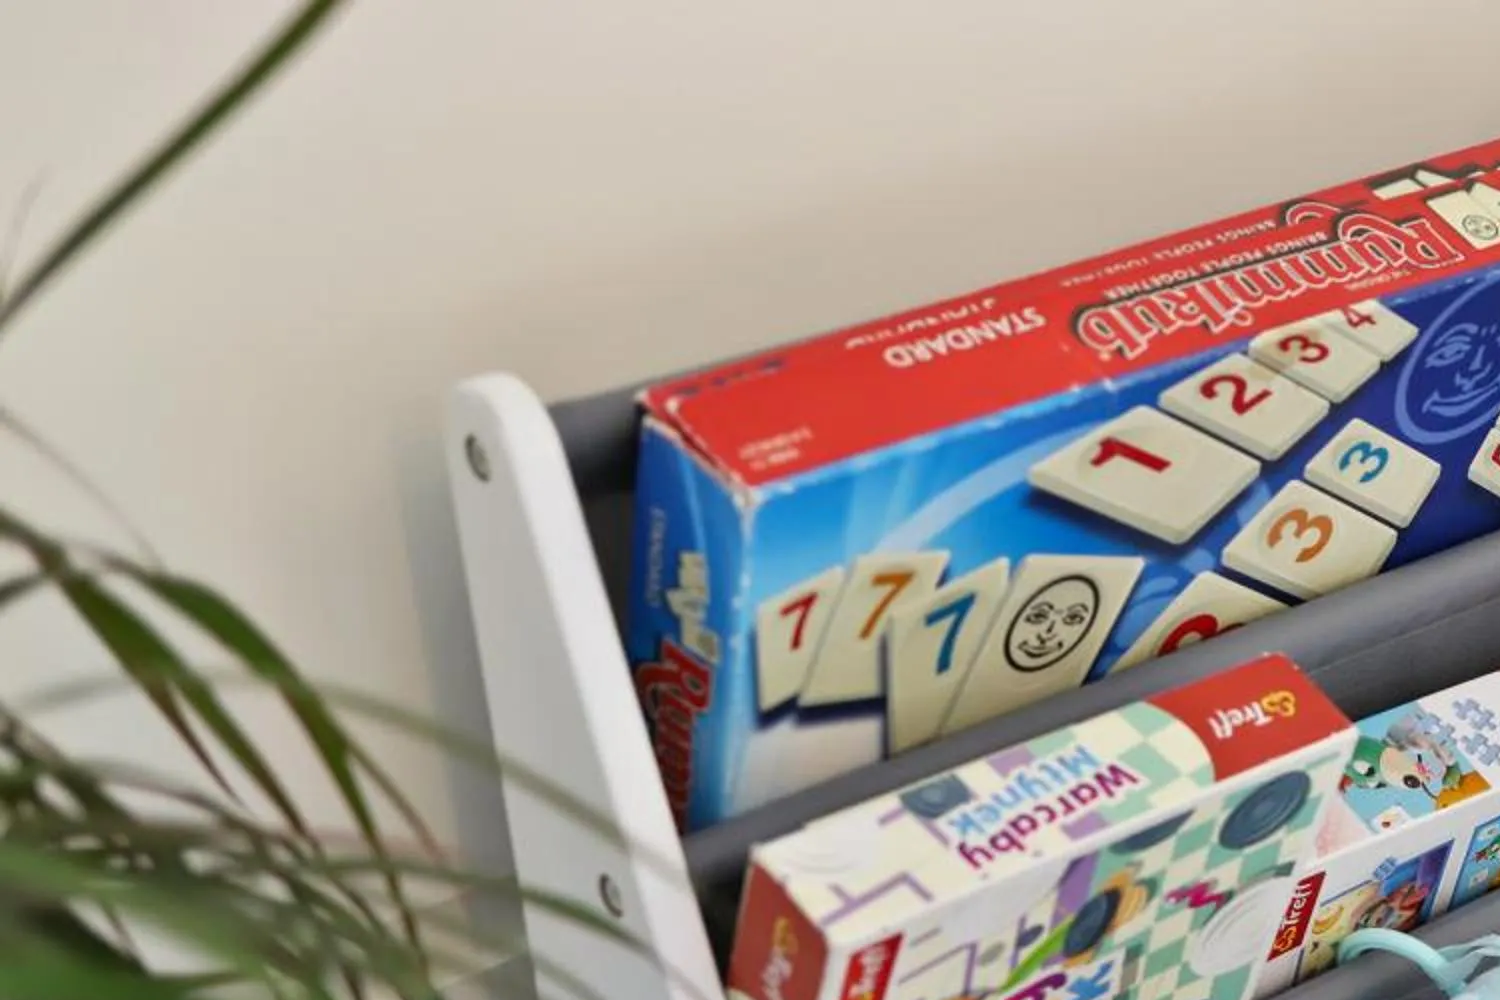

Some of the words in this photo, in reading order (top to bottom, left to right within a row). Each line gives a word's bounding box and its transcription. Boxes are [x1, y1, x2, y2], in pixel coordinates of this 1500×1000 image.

[1077, 212, 1466, 360] Rummikub
[883, 306, 1046, 369] STANDARD
[1276, 332, 1330, 364] 3
[1200, 372, 1274, 416] 2
[1090, 435, 1172, 475] 1
[1338, 440, 1389, 483] 3
[1266, 507, 1335, 564] 3
[780, 591, 819, 651] 7
[859, 570, 915, 641] 7
[924, 594, 976, 675] 7
[1206, 701, 1274, 740] Trefl
[958, 763, 1140, 869] Warcaby
